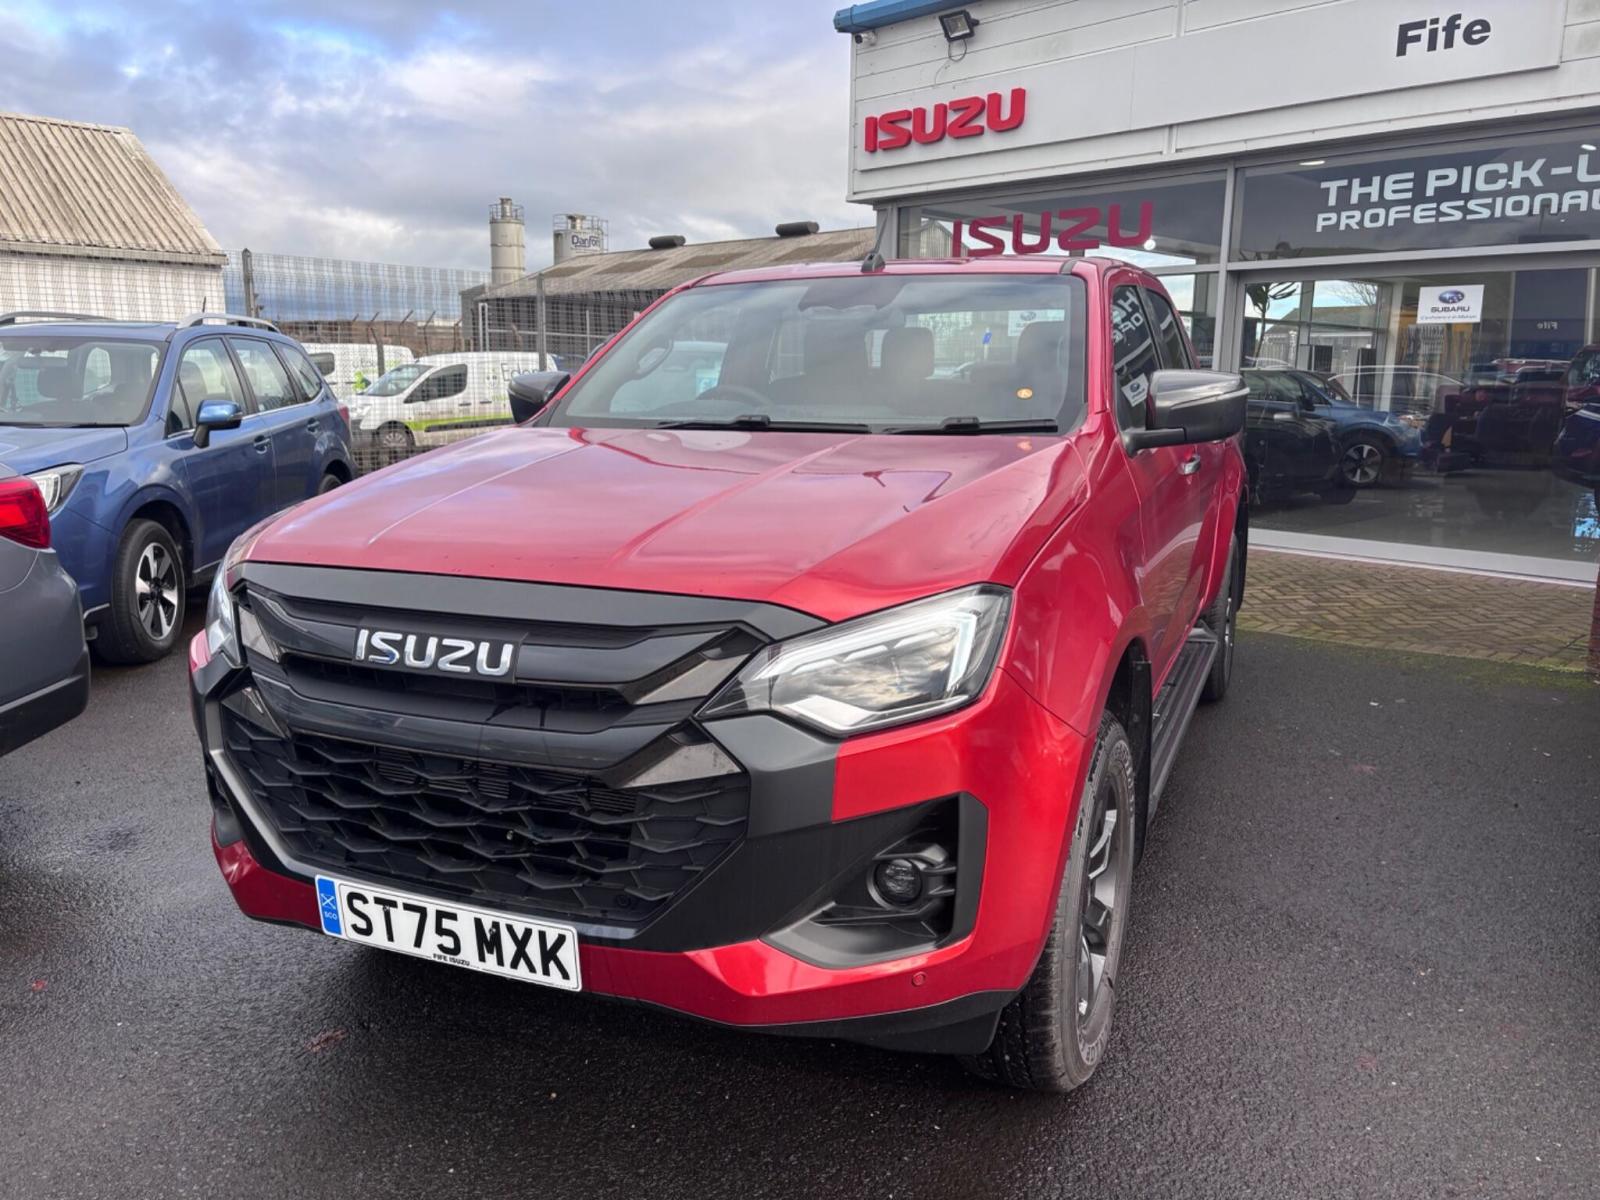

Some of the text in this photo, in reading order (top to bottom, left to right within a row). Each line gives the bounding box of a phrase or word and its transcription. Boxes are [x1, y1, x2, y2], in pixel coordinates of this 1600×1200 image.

[1396, 13, 1491, 57] Fife
[864, 87, 1026, 152] ISUZU
[1320, 171, 1415, 207] THE
[952, 201, 1153, 257] ISUZU
[355, 629, 514, 676] ISUZU
[346, 891, 571, 981] ST75 MXK
